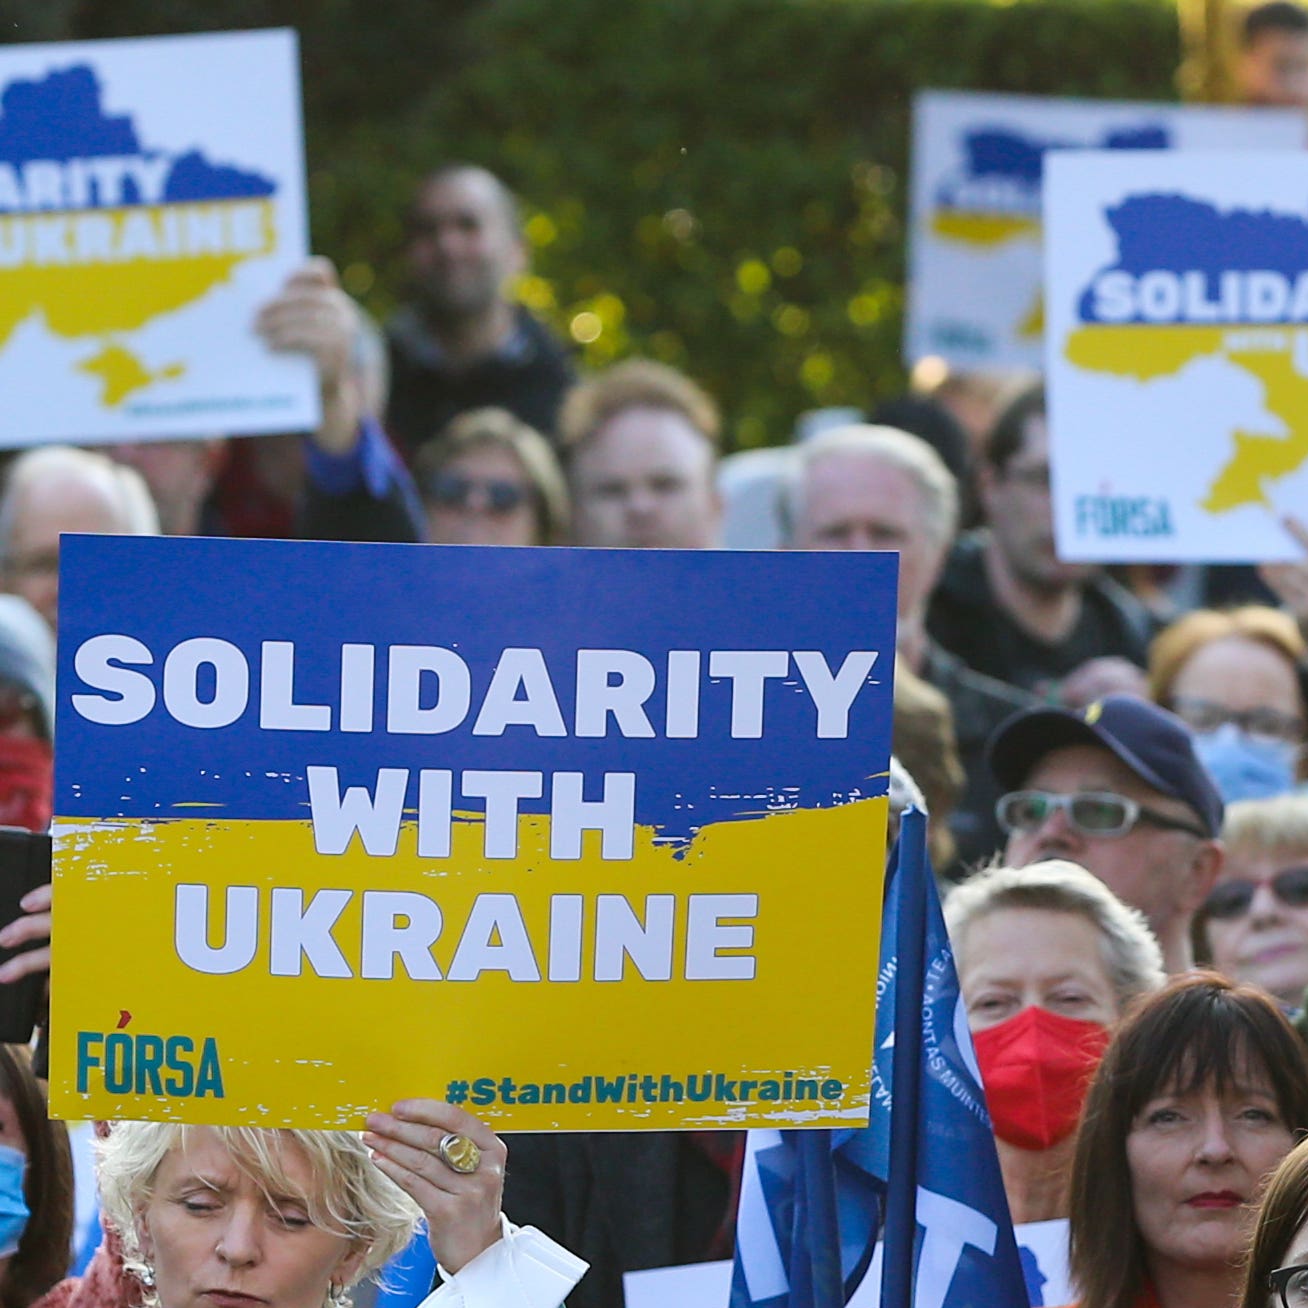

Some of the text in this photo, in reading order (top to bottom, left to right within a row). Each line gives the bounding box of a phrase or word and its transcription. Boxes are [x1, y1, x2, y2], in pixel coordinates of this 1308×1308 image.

[72, 634, 879, 740] SOLIDARITY
[306, 765, 635, 861] WITH
[174, 883, 759, 981] UKRAINE
[76, 1010, 225, 1099] FÓRSA
[445, 1072, 844, 1106] #StandWithUkraine
